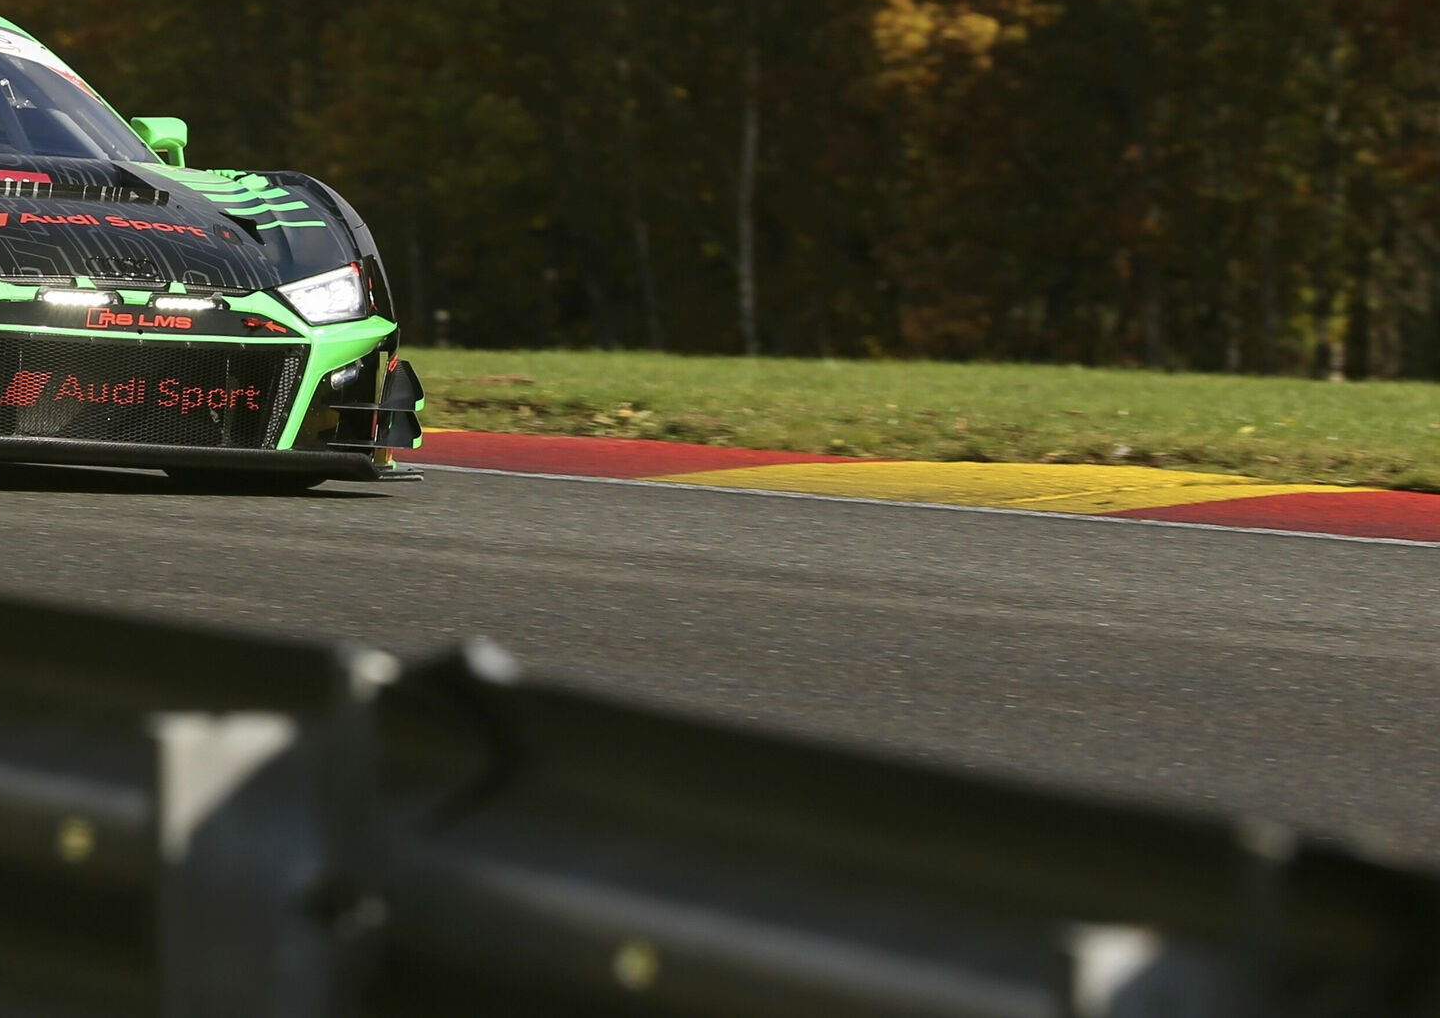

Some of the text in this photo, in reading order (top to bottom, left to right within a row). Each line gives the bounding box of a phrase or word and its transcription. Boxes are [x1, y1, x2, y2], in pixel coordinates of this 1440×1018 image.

[20, 212, 208, 238] Audi Sport
[98, 312, 193, 329] R8 LMS
[54, 374, 260, 415] Audi Sport
